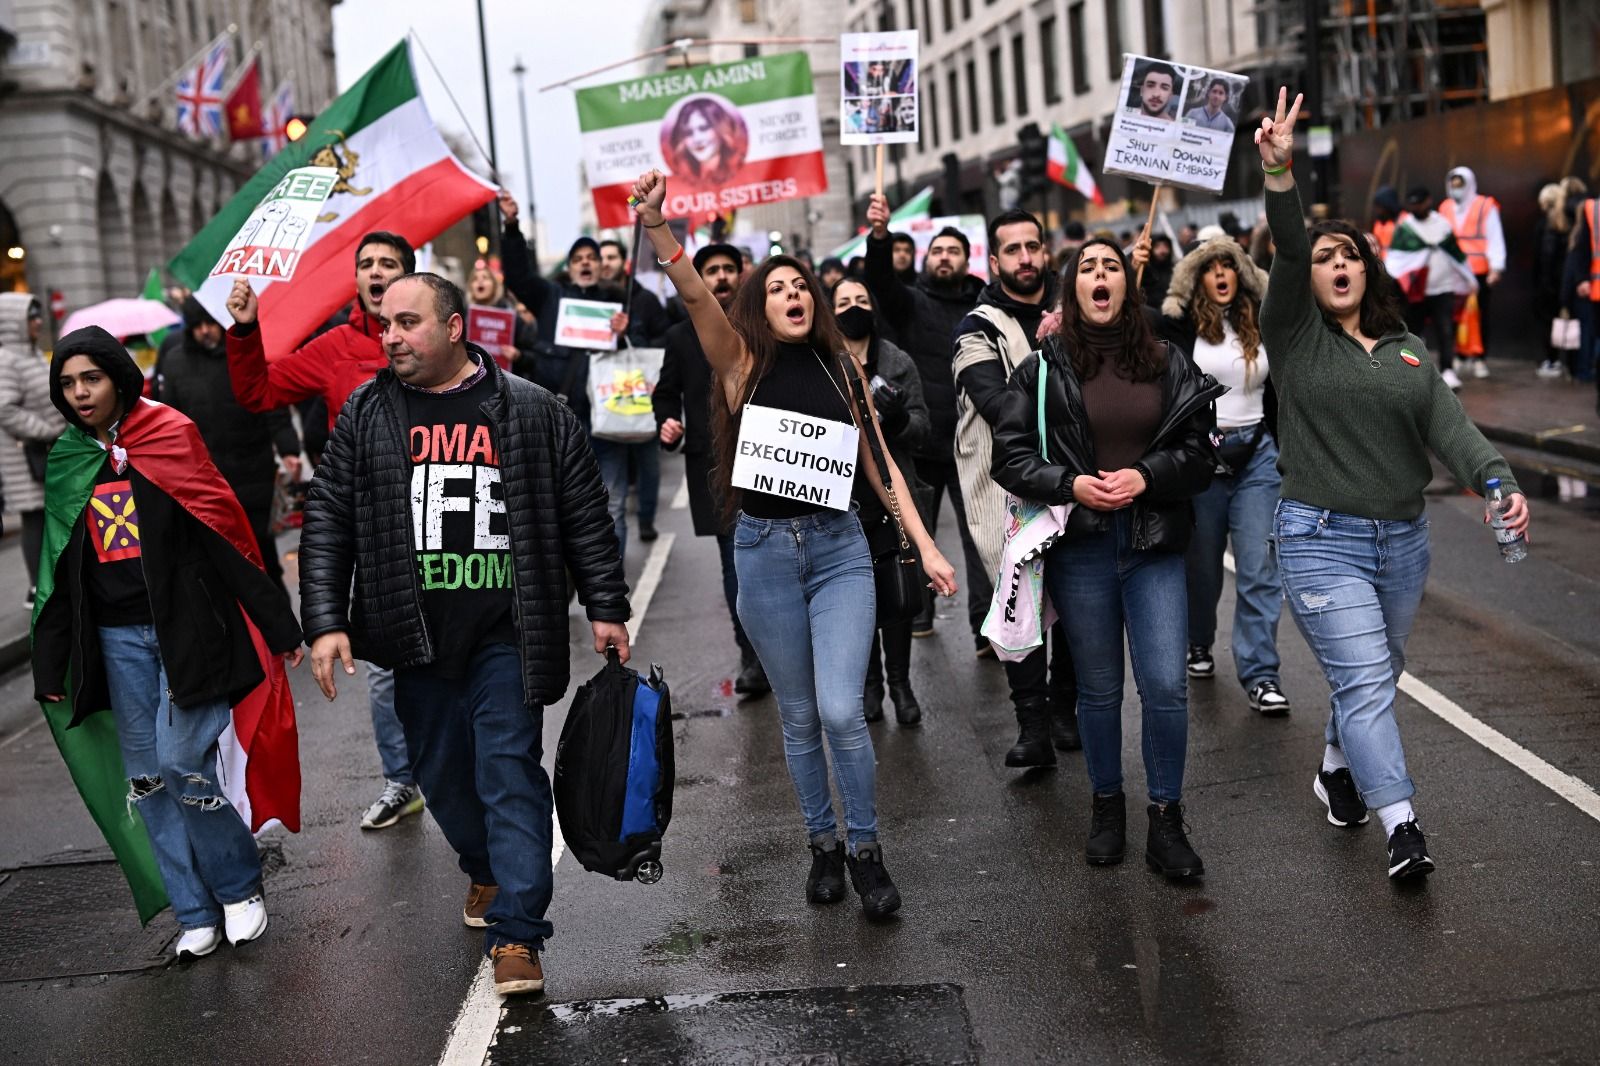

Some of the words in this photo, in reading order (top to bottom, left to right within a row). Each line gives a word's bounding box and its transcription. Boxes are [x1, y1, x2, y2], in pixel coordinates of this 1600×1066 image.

[619, 74, 698, 103] MAHSA
[702, 61, 767, 90] AMINI
[759, 112, 803, 127] NEVER
[600, 138, 643, 153] NEVER
[759, 127, 808, 145] FORGET
[1114, 149, 1170, 171] IRANIAN
[1175, 162, 1222, 180] EMBASSY
[1126, 138, 1158, 152] SHUT
[1172, 148, 1213, 166] DOWN
[671, 192, 718, 215] OUR
[719, 178, 798, 208] SISTERS
[214, 248, 295, 277] IRAN
[778, 418, 826, 439] STOP
[410, 424, 499, 465] OMA
[740, 440, 853, 478] EXECUTIONS
[753, 474, 773, 491] IN
[778, 479, 830, 504] IRAN!
[411, 464, 510, 550] IFE
[416, 553, 512, 590] EDOM
